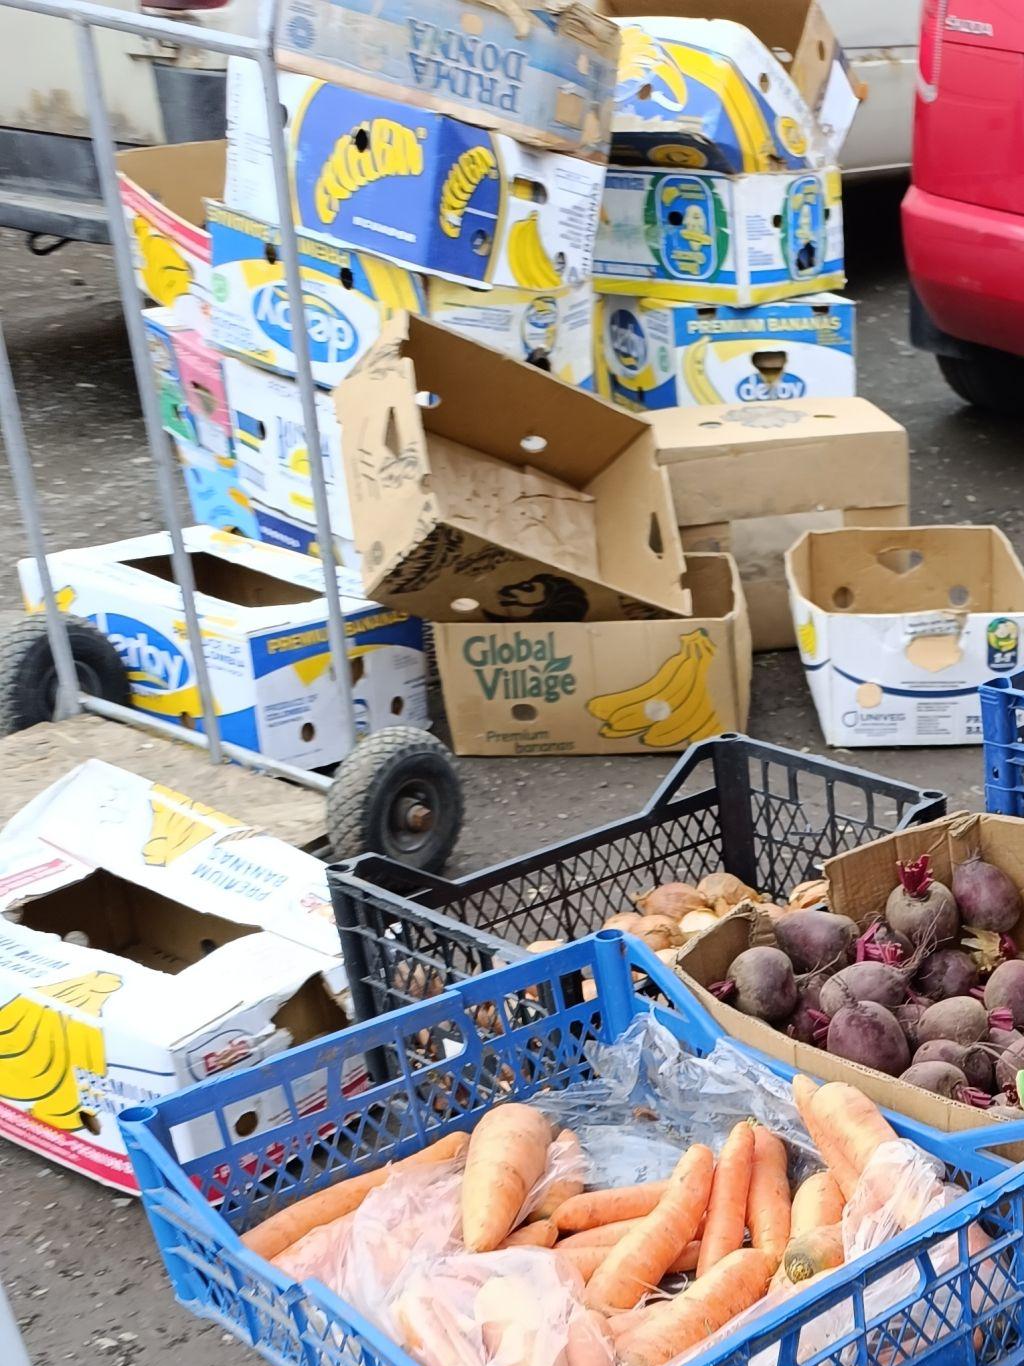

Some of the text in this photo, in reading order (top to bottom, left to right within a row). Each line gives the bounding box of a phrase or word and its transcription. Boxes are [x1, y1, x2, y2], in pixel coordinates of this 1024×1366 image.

[408, 52, 521, 113] PRIMA
[256, 286, 357, 363] deby
[686, 318, 766, 334] PREMIUM
[768, 316, 842, 332] BANANAS
[95, 612, 185, 691] erby
[463, 631, 572, 667] Global
[473, 667, 577, 703] Village
[486, 729, 549, 743] Premium
[514, 740, 576, 754] bananas
